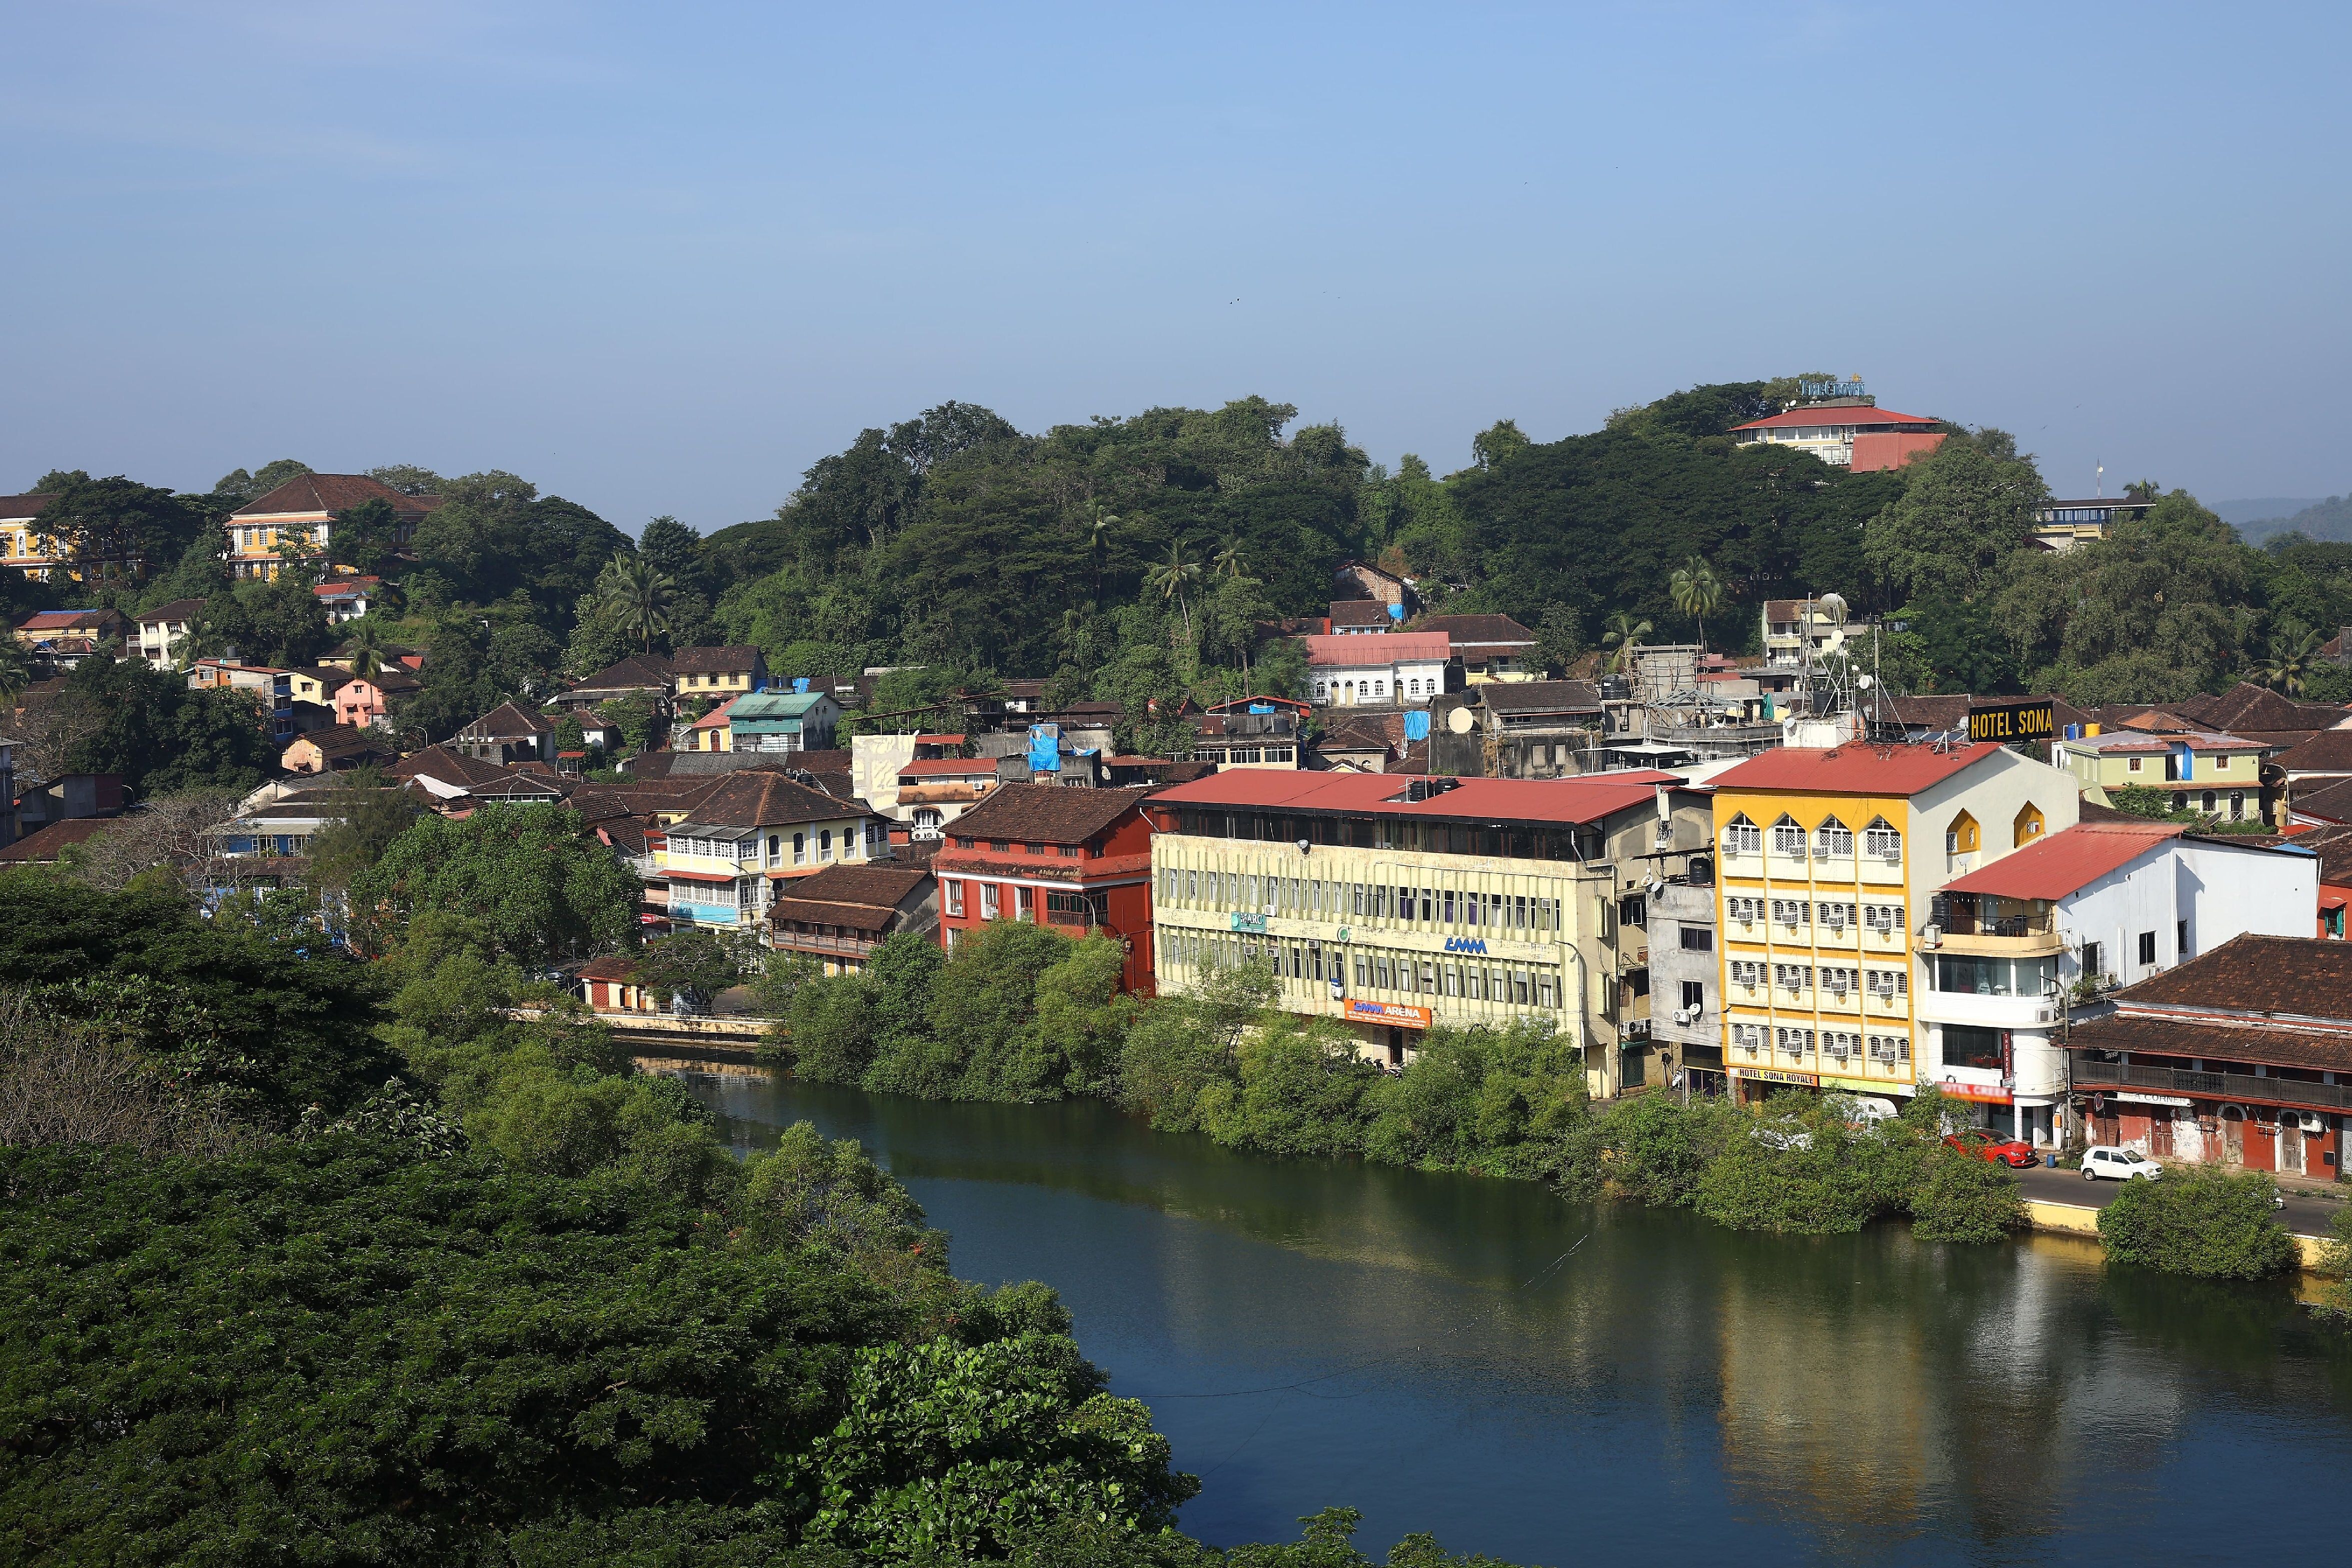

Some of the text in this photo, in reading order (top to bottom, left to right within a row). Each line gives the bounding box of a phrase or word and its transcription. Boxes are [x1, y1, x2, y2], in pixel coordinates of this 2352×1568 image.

[1799, 380, 1865, 396] THE CROWN
[1971, 708, 2053, 739] HOTEL SONA
[1240, 913, 1263, 924] MARC
[1384, 1006, 1421, 1018] ARENA
[1739, 1068, 1762, 1078] HOTEL
[1764, 1071, 1784, 1081] SONA
[1786, 1074, 1814, 1084] ROYALE
